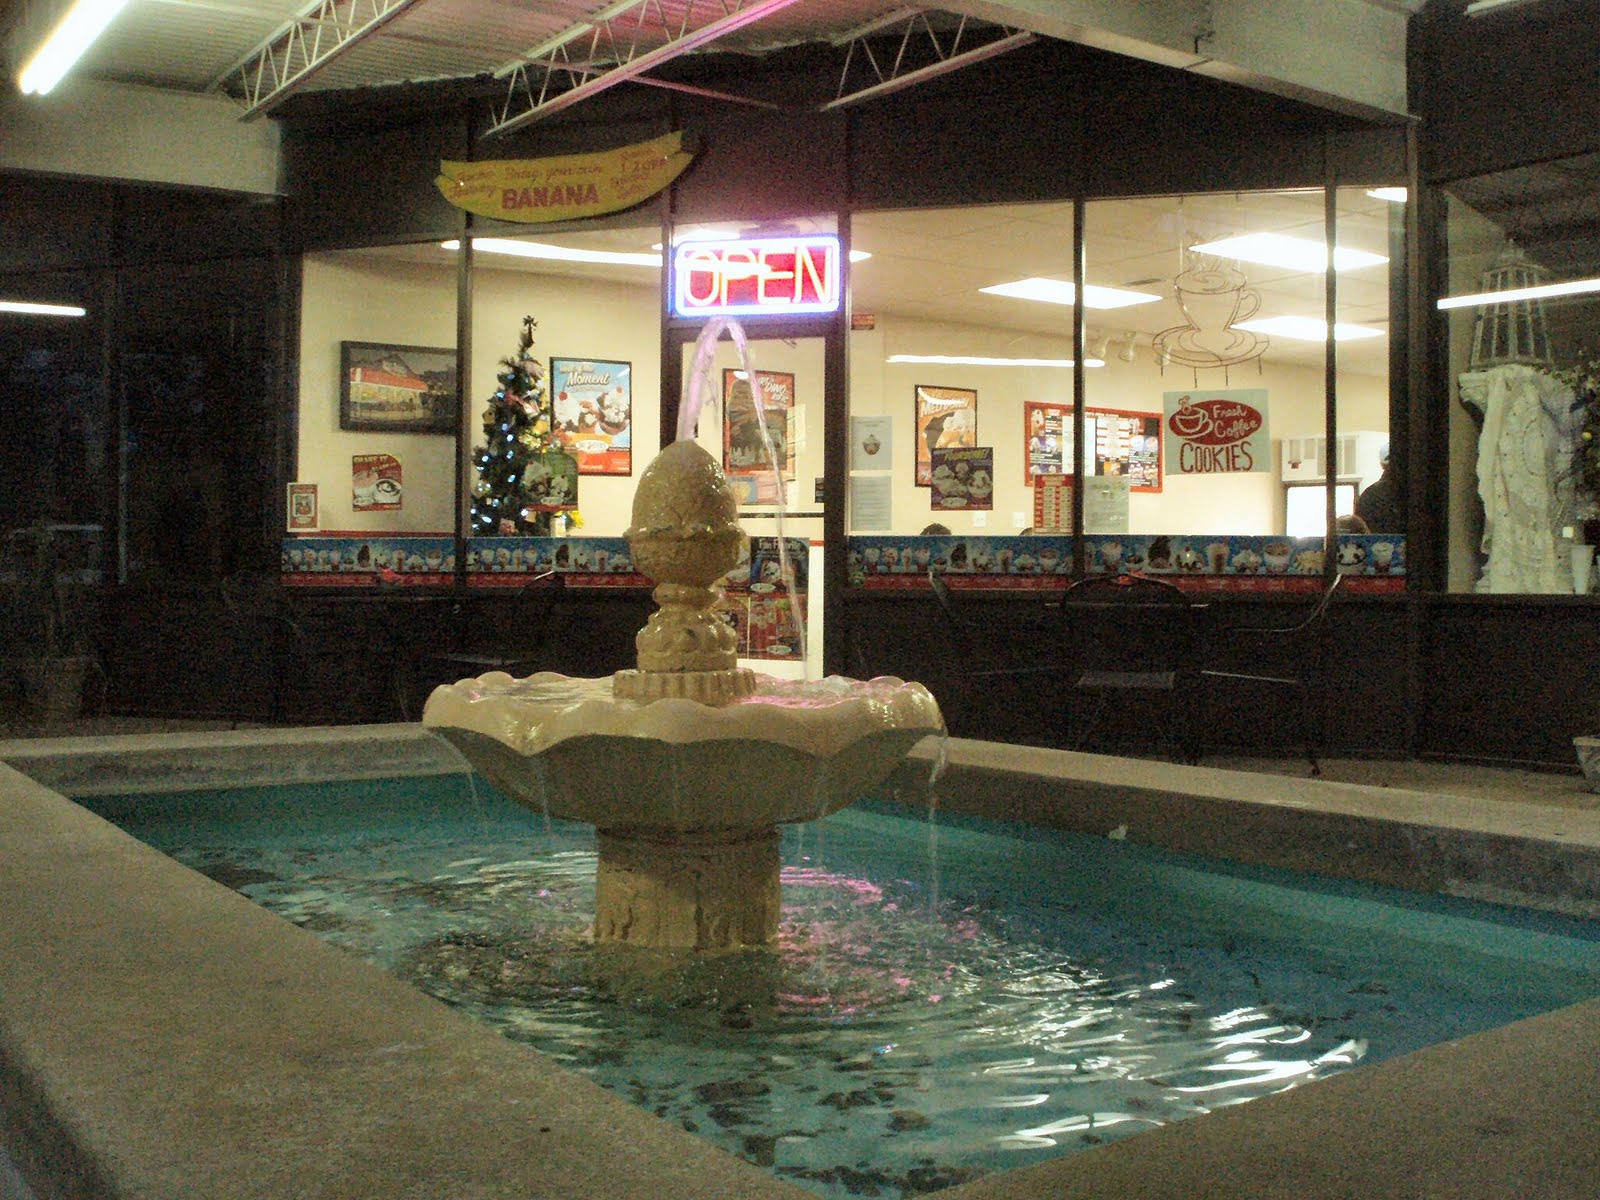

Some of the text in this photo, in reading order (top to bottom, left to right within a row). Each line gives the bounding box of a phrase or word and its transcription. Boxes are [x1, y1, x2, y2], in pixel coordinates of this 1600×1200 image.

[502, 183, 600, 210] BANANA
[685, 247, 833, 307] OPEN
[566, 372, 610, 388] Moment
[1212, 404, 1248, 419] Fresh
[1214, 419, 1258, 438] Coffee
[1179, 440, 1254, 473] COOKIES
